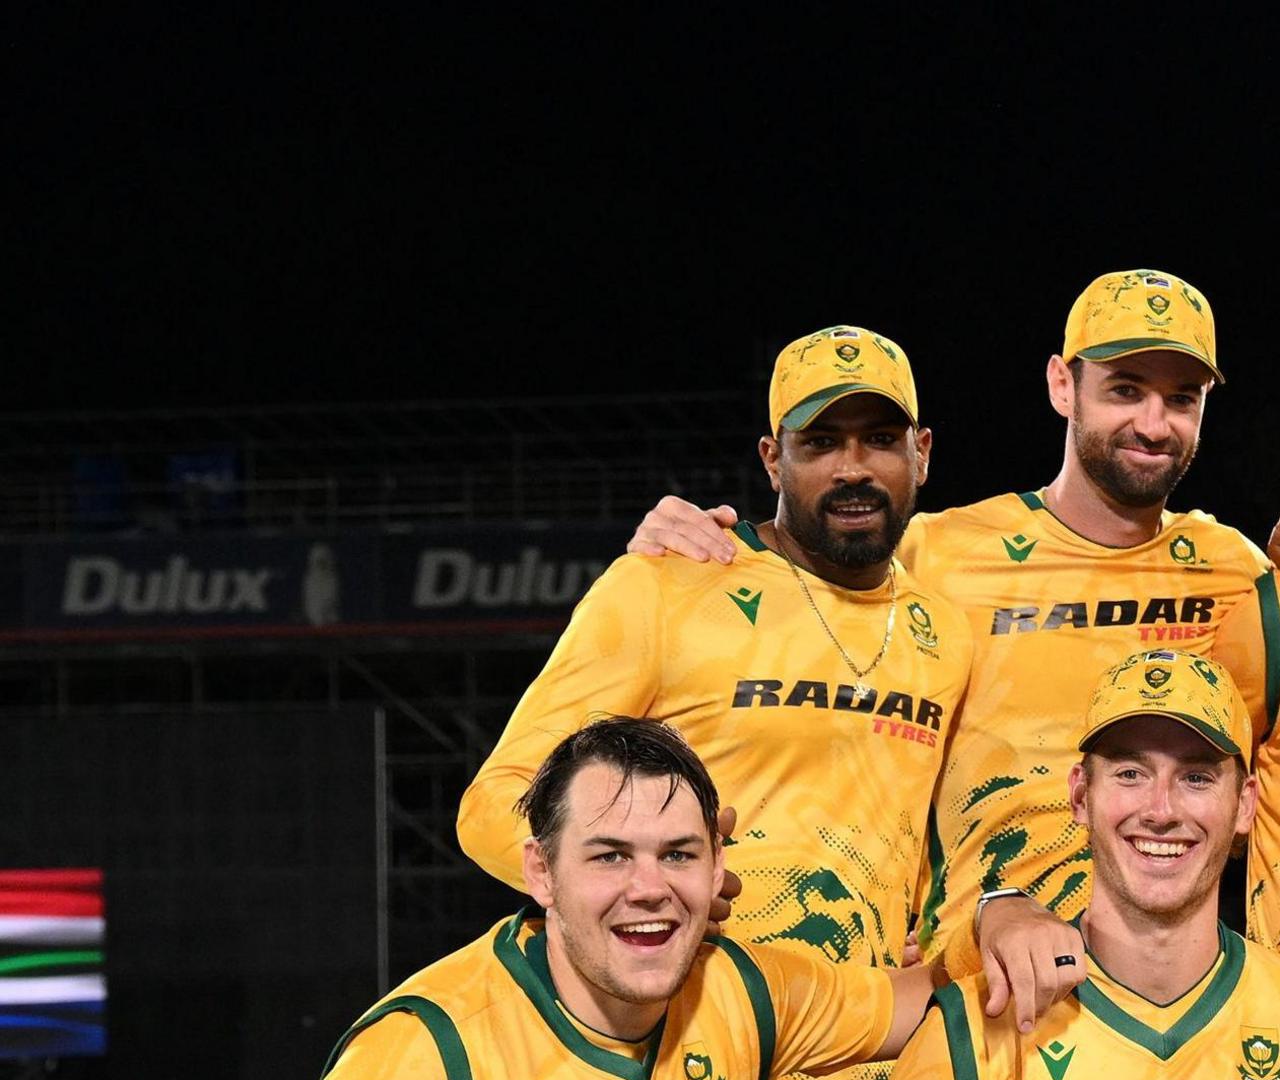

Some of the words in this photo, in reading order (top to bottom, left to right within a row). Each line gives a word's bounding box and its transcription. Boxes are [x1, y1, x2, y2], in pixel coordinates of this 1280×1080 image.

[61, 555, 274, 616] Dulux
[990, 597, 1216, 636] RADAR
[1138, 626, 1210, 642] TYRES
[731, 679, 944, 732] RADAR
[872, 717, 938, 749] TYRES
